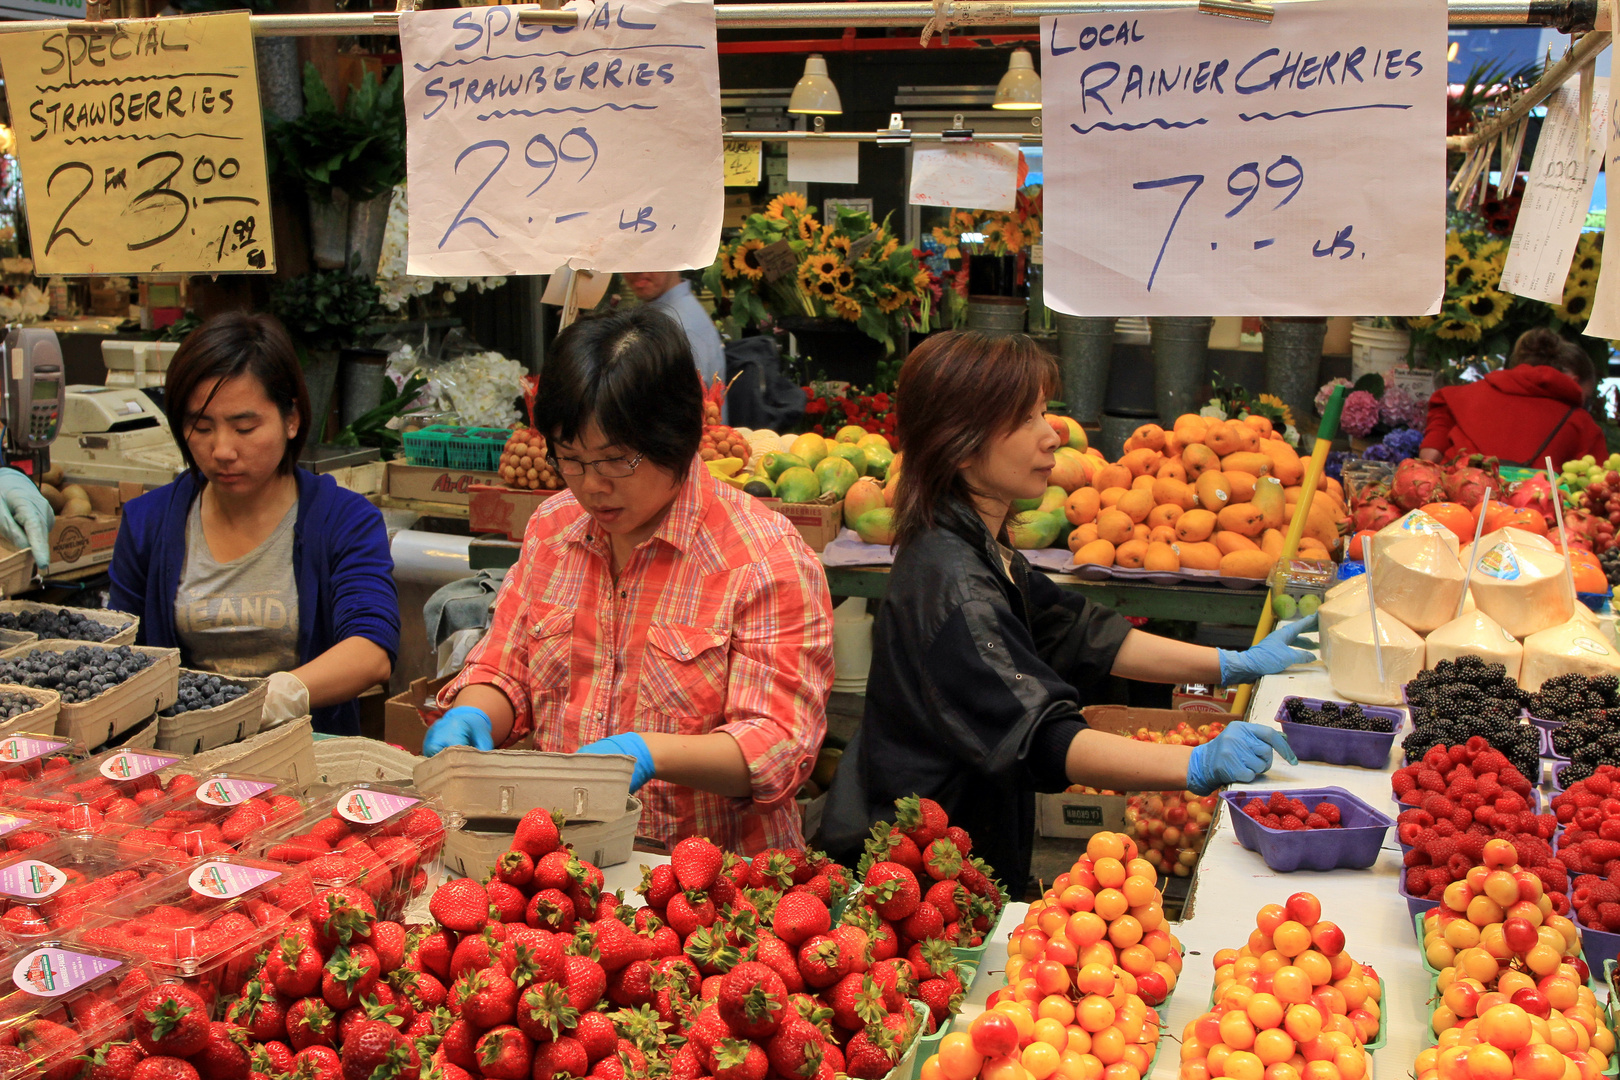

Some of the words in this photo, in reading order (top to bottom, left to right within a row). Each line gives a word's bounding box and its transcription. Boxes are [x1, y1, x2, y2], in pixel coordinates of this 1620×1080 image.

[41, 27, 190, 84] SPECIAL
[1051, 17, 1144, 56] LOCAL
[424, 58, 675, 120] STRAWBERRIES
[1080, 58, 1229, 115] RAINIER
[1235, 46, 1423, 94] CHERRIES
[29, 86, 234, 142] STRAWBERRIES
[46, 161, 94, 257] 2
[771, 506, 822, 516] RASPBERRIES
